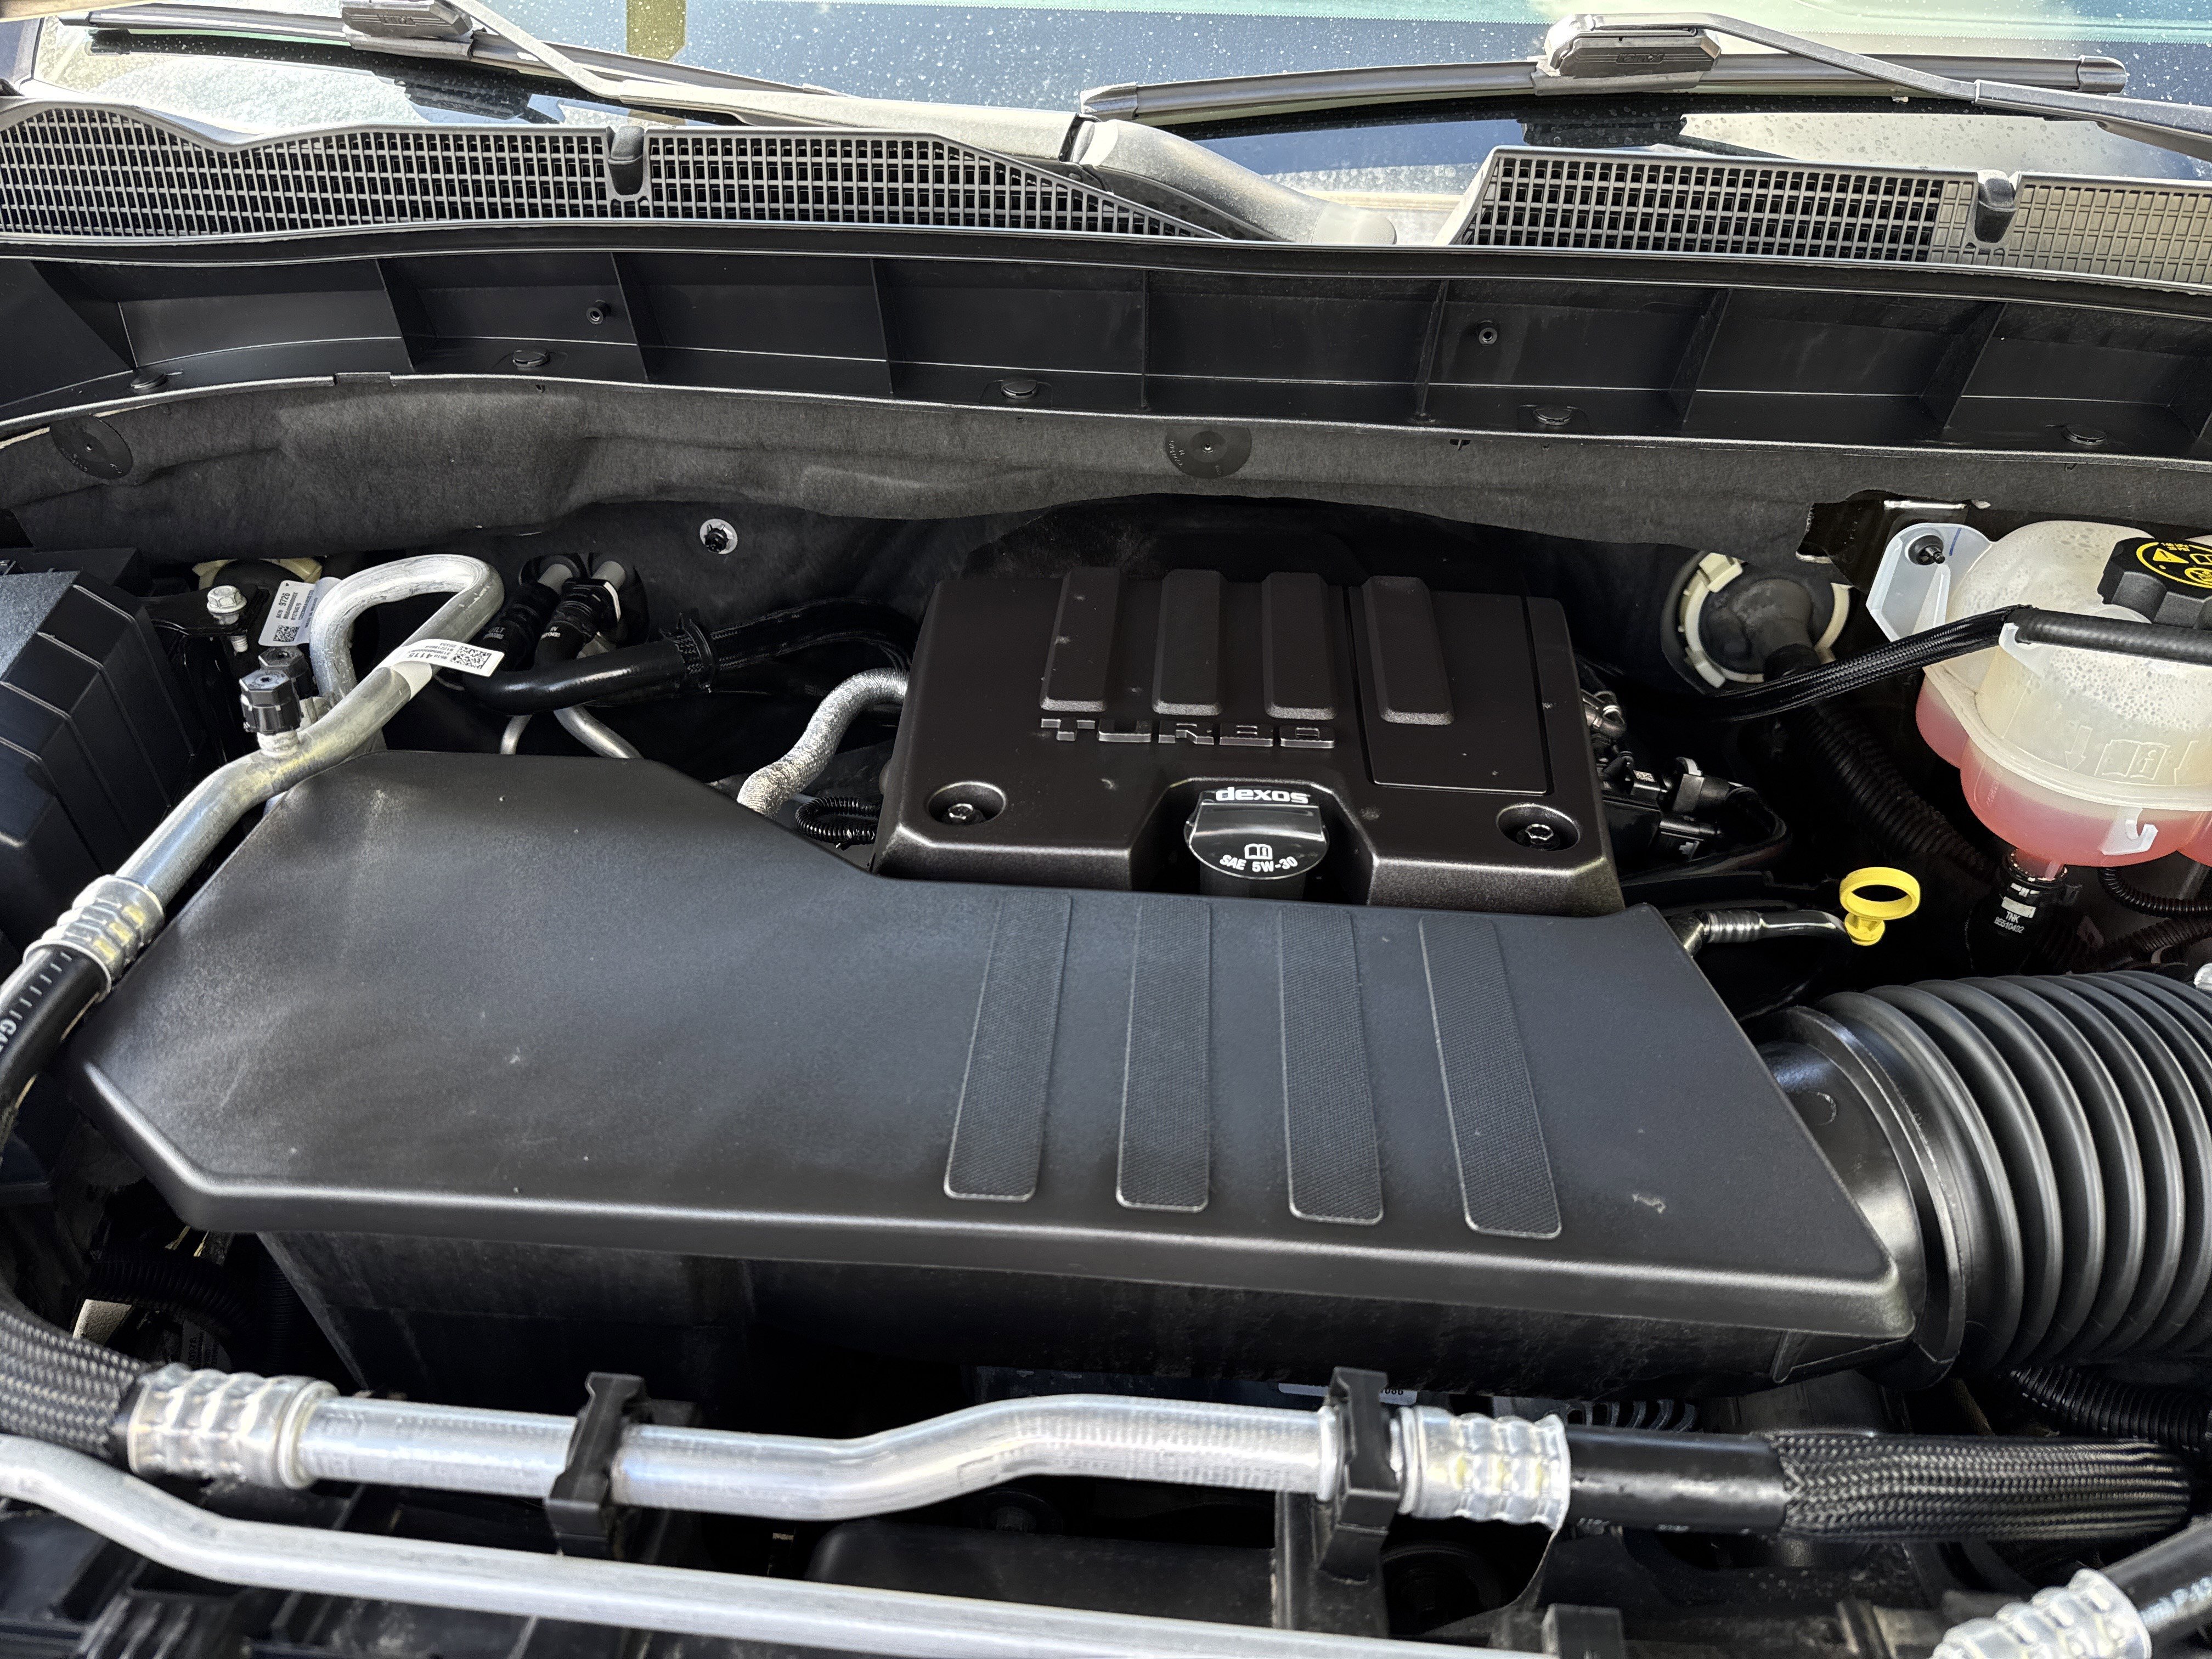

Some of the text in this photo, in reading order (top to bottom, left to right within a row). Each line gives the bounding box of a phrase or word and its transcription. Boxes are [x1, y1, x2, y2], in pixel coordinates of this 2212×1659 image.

[278, 592, 290, 606] 9726
[1041, 718, 1335, 749] TURBO
[1215, 786, 1310, 804] dexos
[1219, 854, 1299, 873] SAE 5W-30
[2006, 911, 2021, 924] TNK
